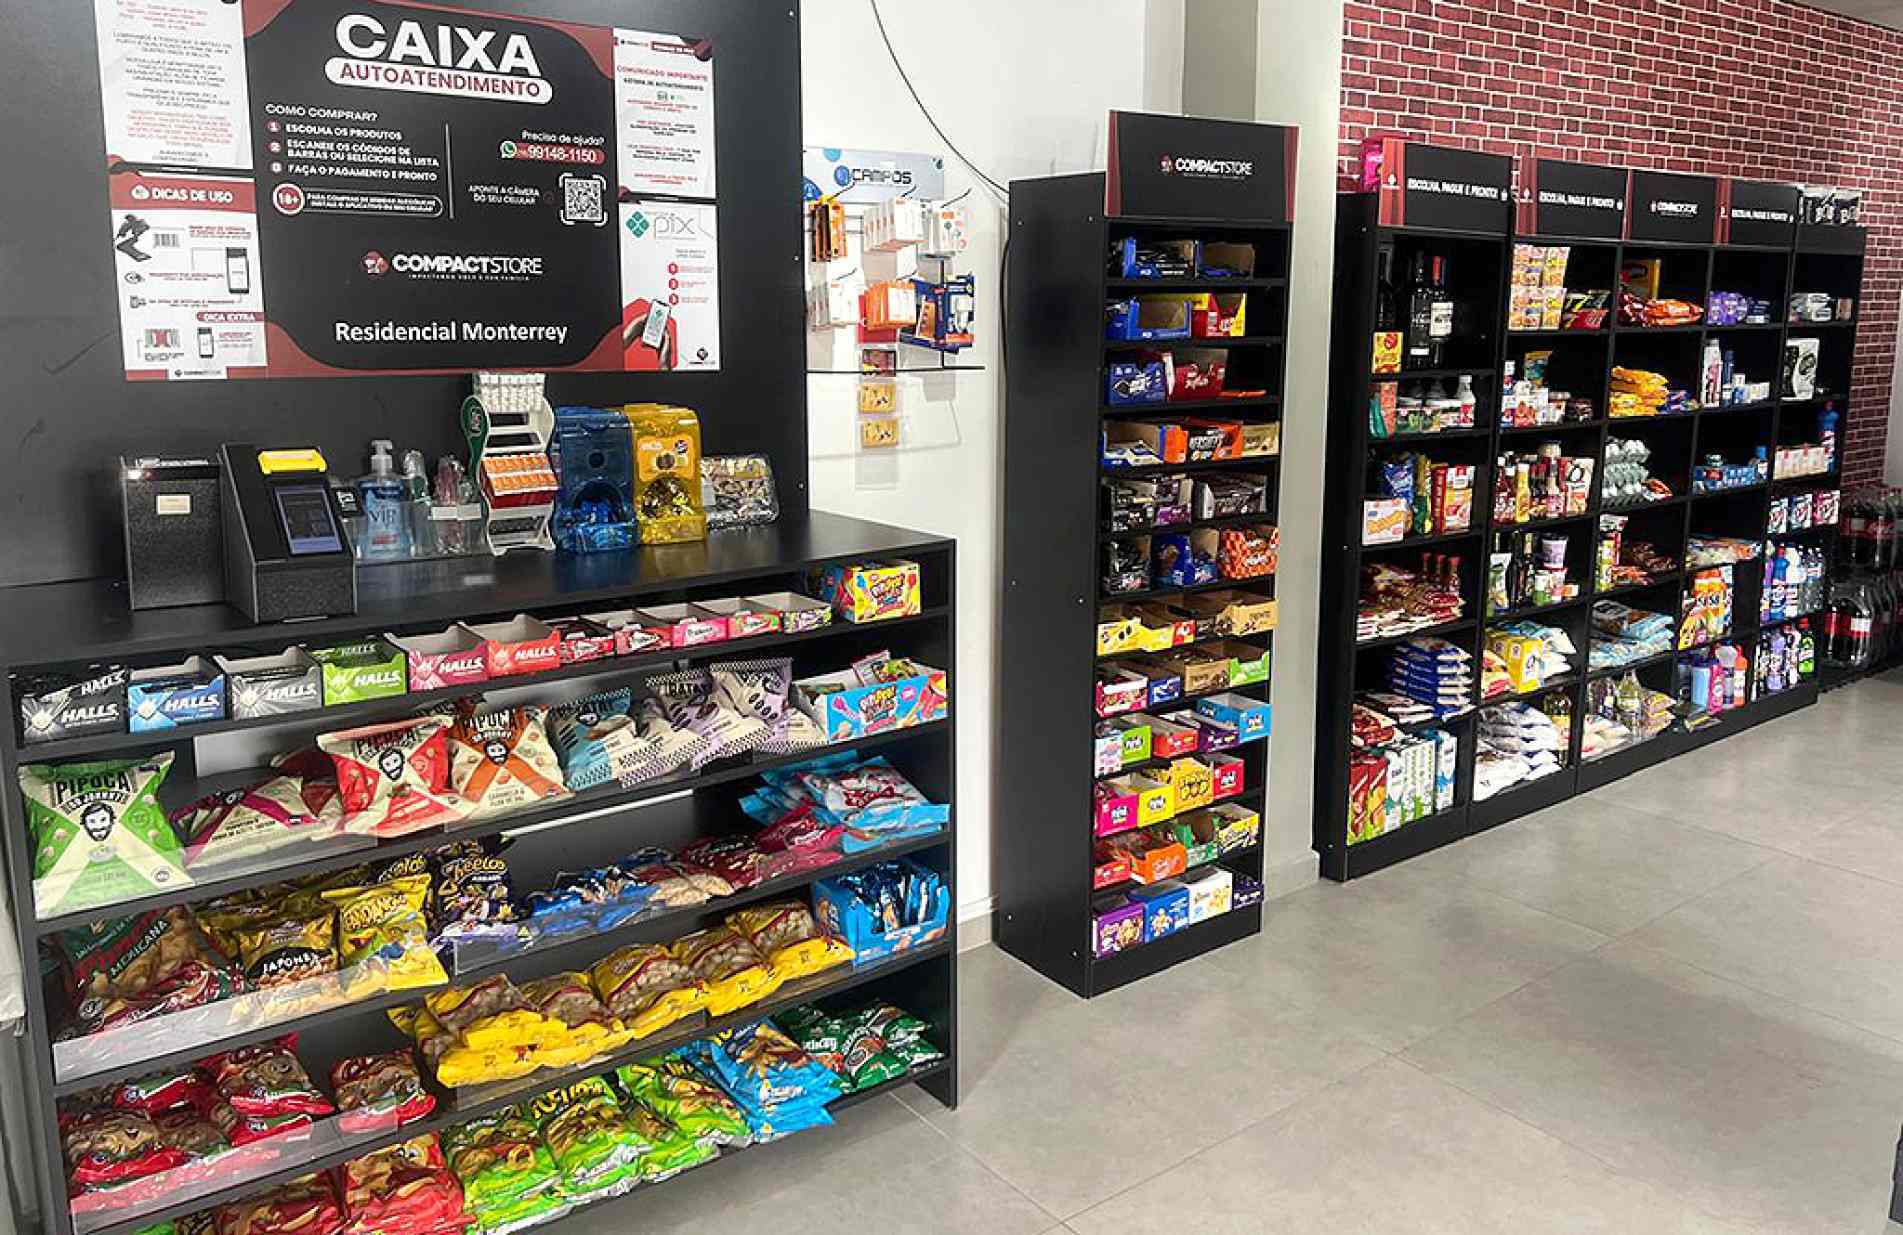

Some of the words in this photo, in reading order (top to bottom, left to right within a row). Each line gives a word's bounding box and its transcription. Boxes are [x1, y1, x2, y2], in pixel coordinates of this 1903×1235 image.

[335, 14, 542, 77] CAIXA
[339, 62, 540, 97] AUTOATENDIMENTO
[265, 103, 305, 116] COMO
[308, 106, 378, 121] COMPRAR?
[286, 123, 333, 137] ESCOLHA
[334, 126, 347, 137] OS
[349, 127, 402, 141] PRODUTOS
[522, 129, 557, 144] Preciso
[558, 132, 571, 144] de
[573, 134, 605, 147] ajuda?
[287, 149, 328, 161] BARRAS
[330, 151, 345, 162] OU
[347, 152, 396, 164] SELECIONE
[414, 156, 439, 168] LISTA
[527, 145, 597, 163] 99148-1150
[288, 164, 316, 176] FAÇA
[328, 167, 390, 179] PAGAMENTO
[399, 170, 438, 181] PRONTO
[1175, 157, 1253, 176] COMPACTSTORE
[151, 186, 189, 201] DICAS
[191, 188, 207, 201] DE
[209, 189, 234, 203] USO
[391, 253, 544, 275] COMPACTSTORE
[335, 321, 457, 342] Residencial
[462, 321, 568, 345] Monterrey
[513, 646, 557, 660] HALLS
[440, 655, 486, 673] HALLS
[354, 669, 401, 686] HALLS
[263, 683, 318, 700] HALLS
[164, 693, 220, 712] HALLS
[61, 702, 120, 723] HALLS
[54, 770, 133, 806] PIPOCA
